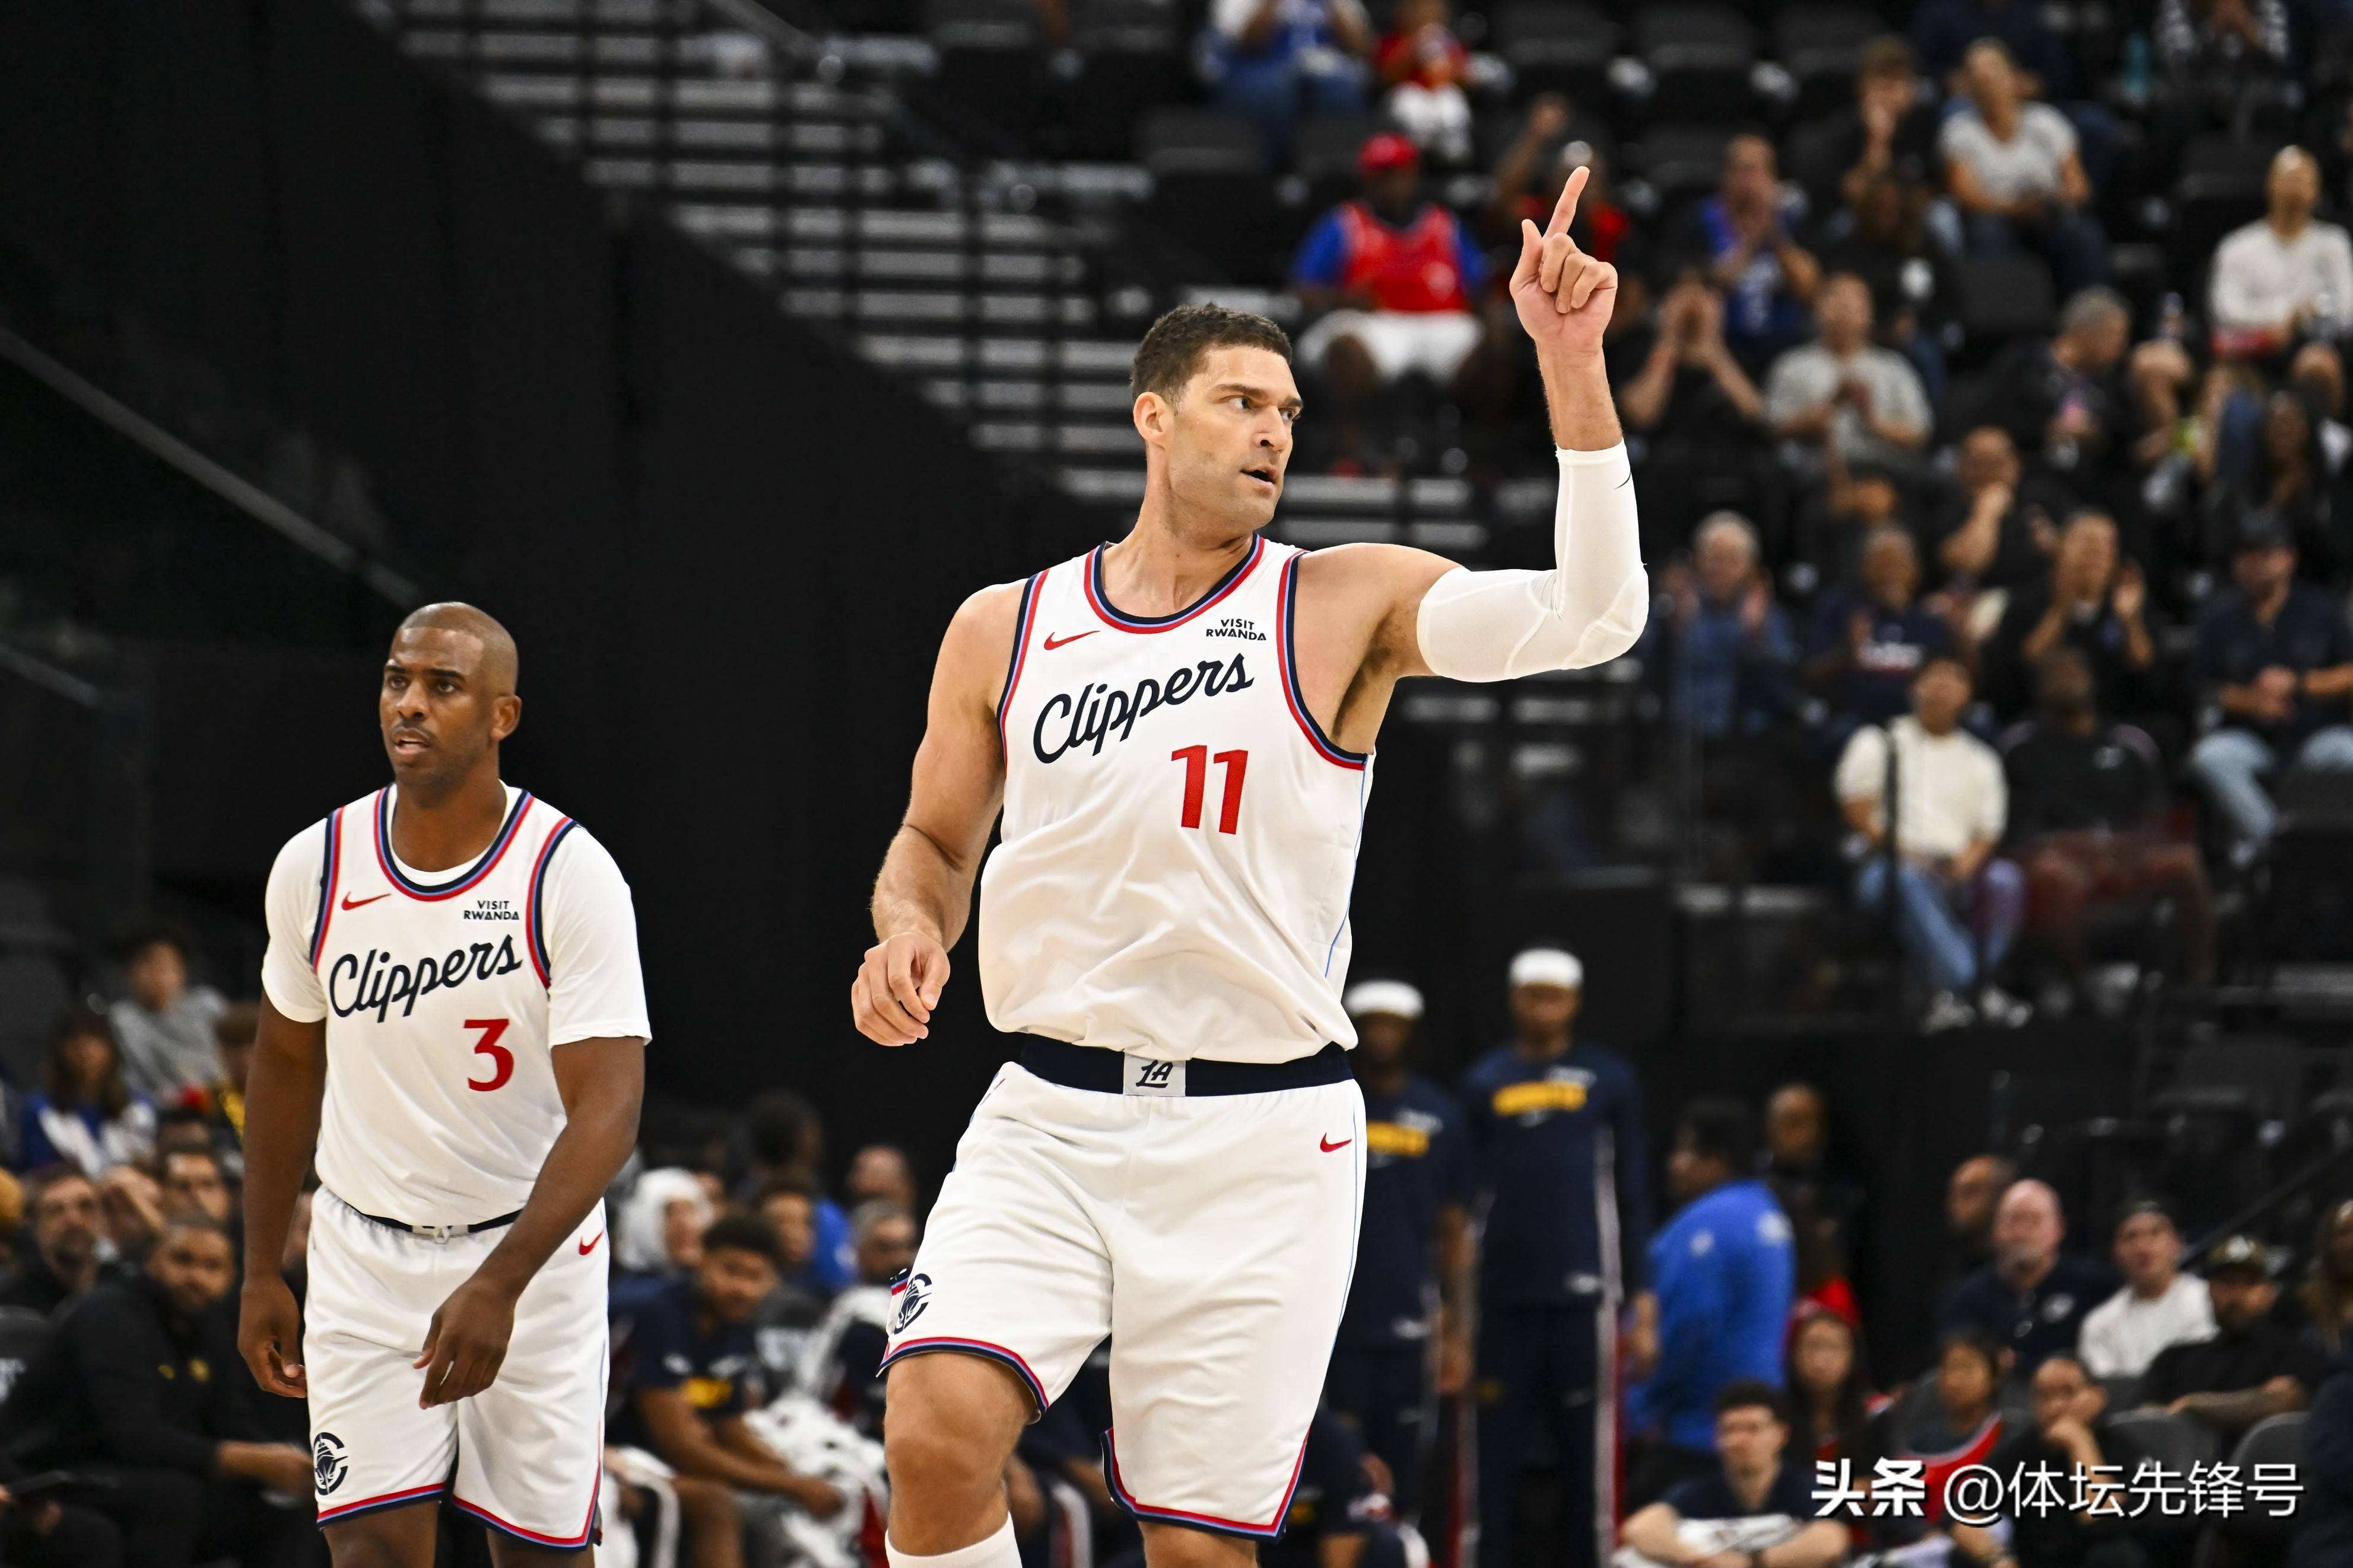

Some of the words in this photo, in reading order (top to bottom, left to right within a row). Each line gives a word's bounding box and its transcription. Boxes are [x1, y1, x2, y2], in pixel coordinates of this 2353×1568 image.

[1206, 628, 1266, 641] RWANDA
[1221, 619, 1255, 630] VISIT
[1033, 653, 1255, 764] Clippers
[1171, 745, 1249, 835] 11
[463, 910, 519, 920] RWANDA
[477, 900, 510, 910] VISIT
[329, 934, 522, 1023] Clippers
[463, 1018, 515, 1092] 3
[1135, 1060, 1174, 1088] LA
